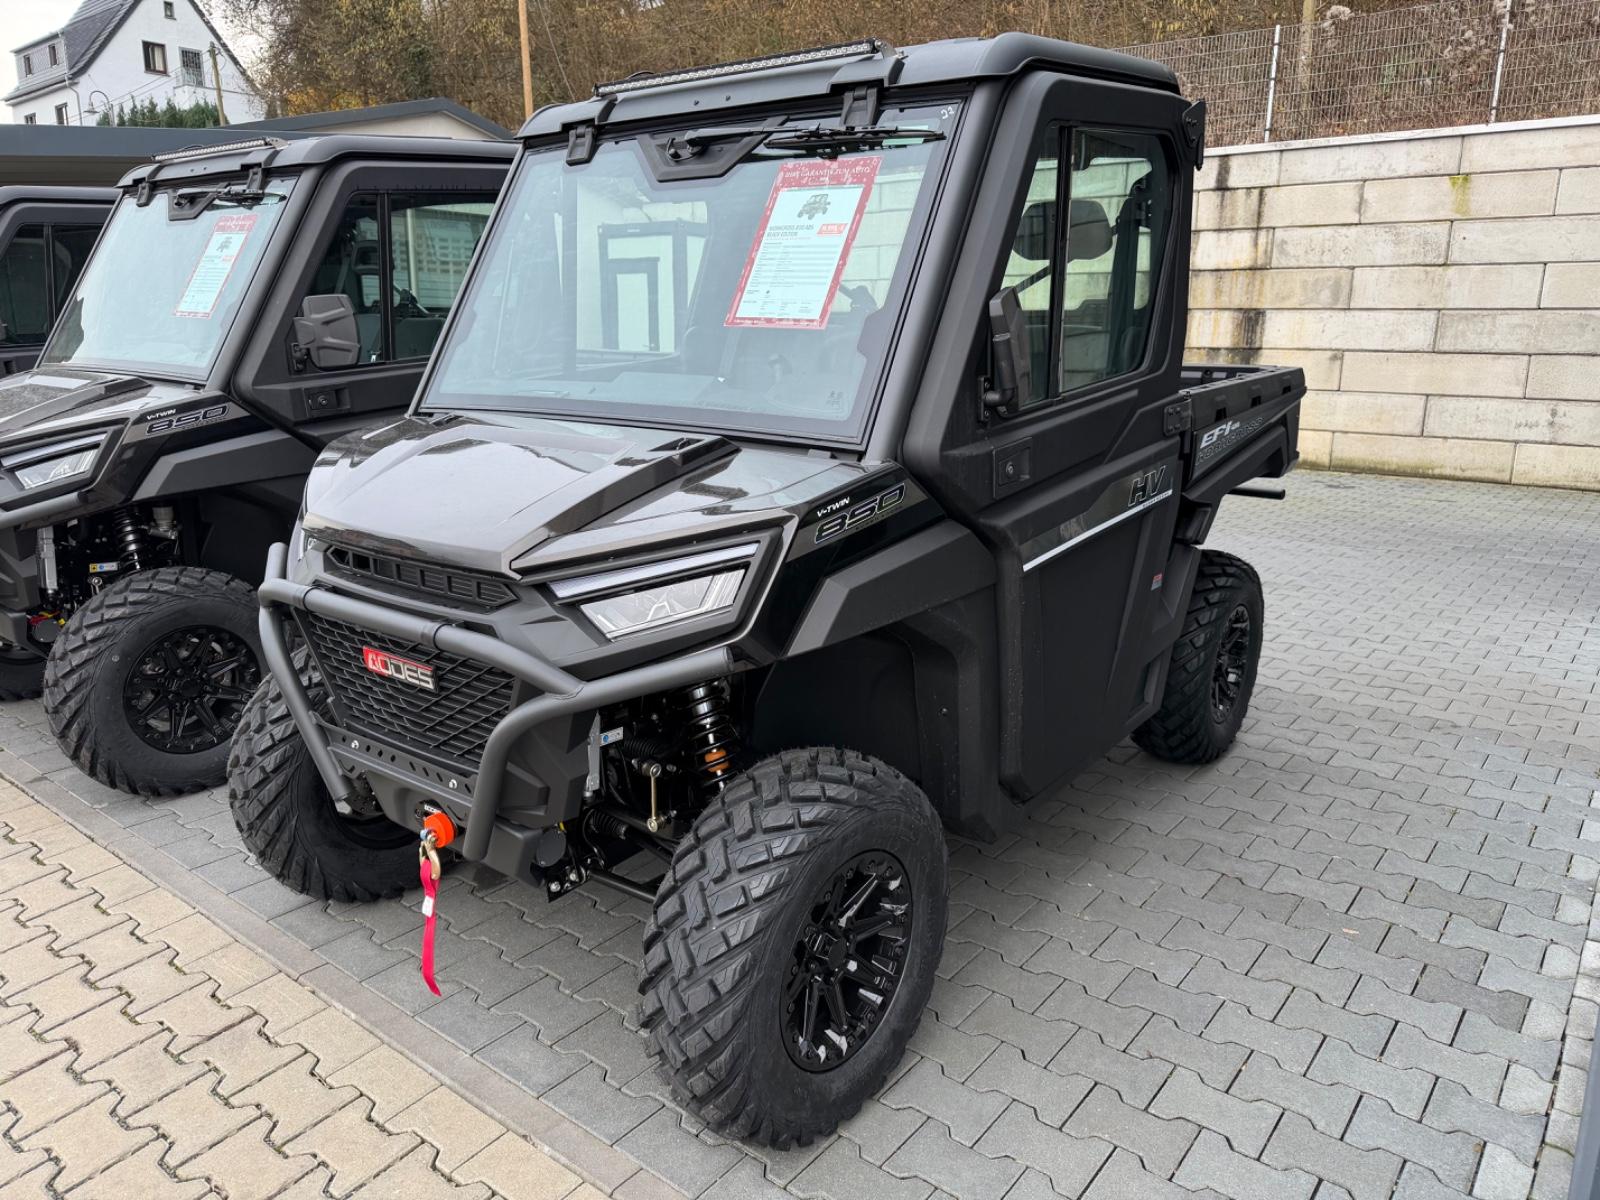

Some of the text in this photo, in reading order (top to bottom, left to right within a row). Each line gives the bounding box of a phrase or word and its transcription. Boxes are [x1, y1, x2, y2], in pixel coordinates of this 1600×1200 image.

[146, 408, 176, 420] V-TWIN
[146, 404, 228, 435] 850
[1200, 421, 1233, 449] EFI
[1127, 464, 1167, 507] HV
[814, 482, 906, 544] 850
[816, 496, 850, 517] V-TWIN
[367, 651, 435, 691] AODES
